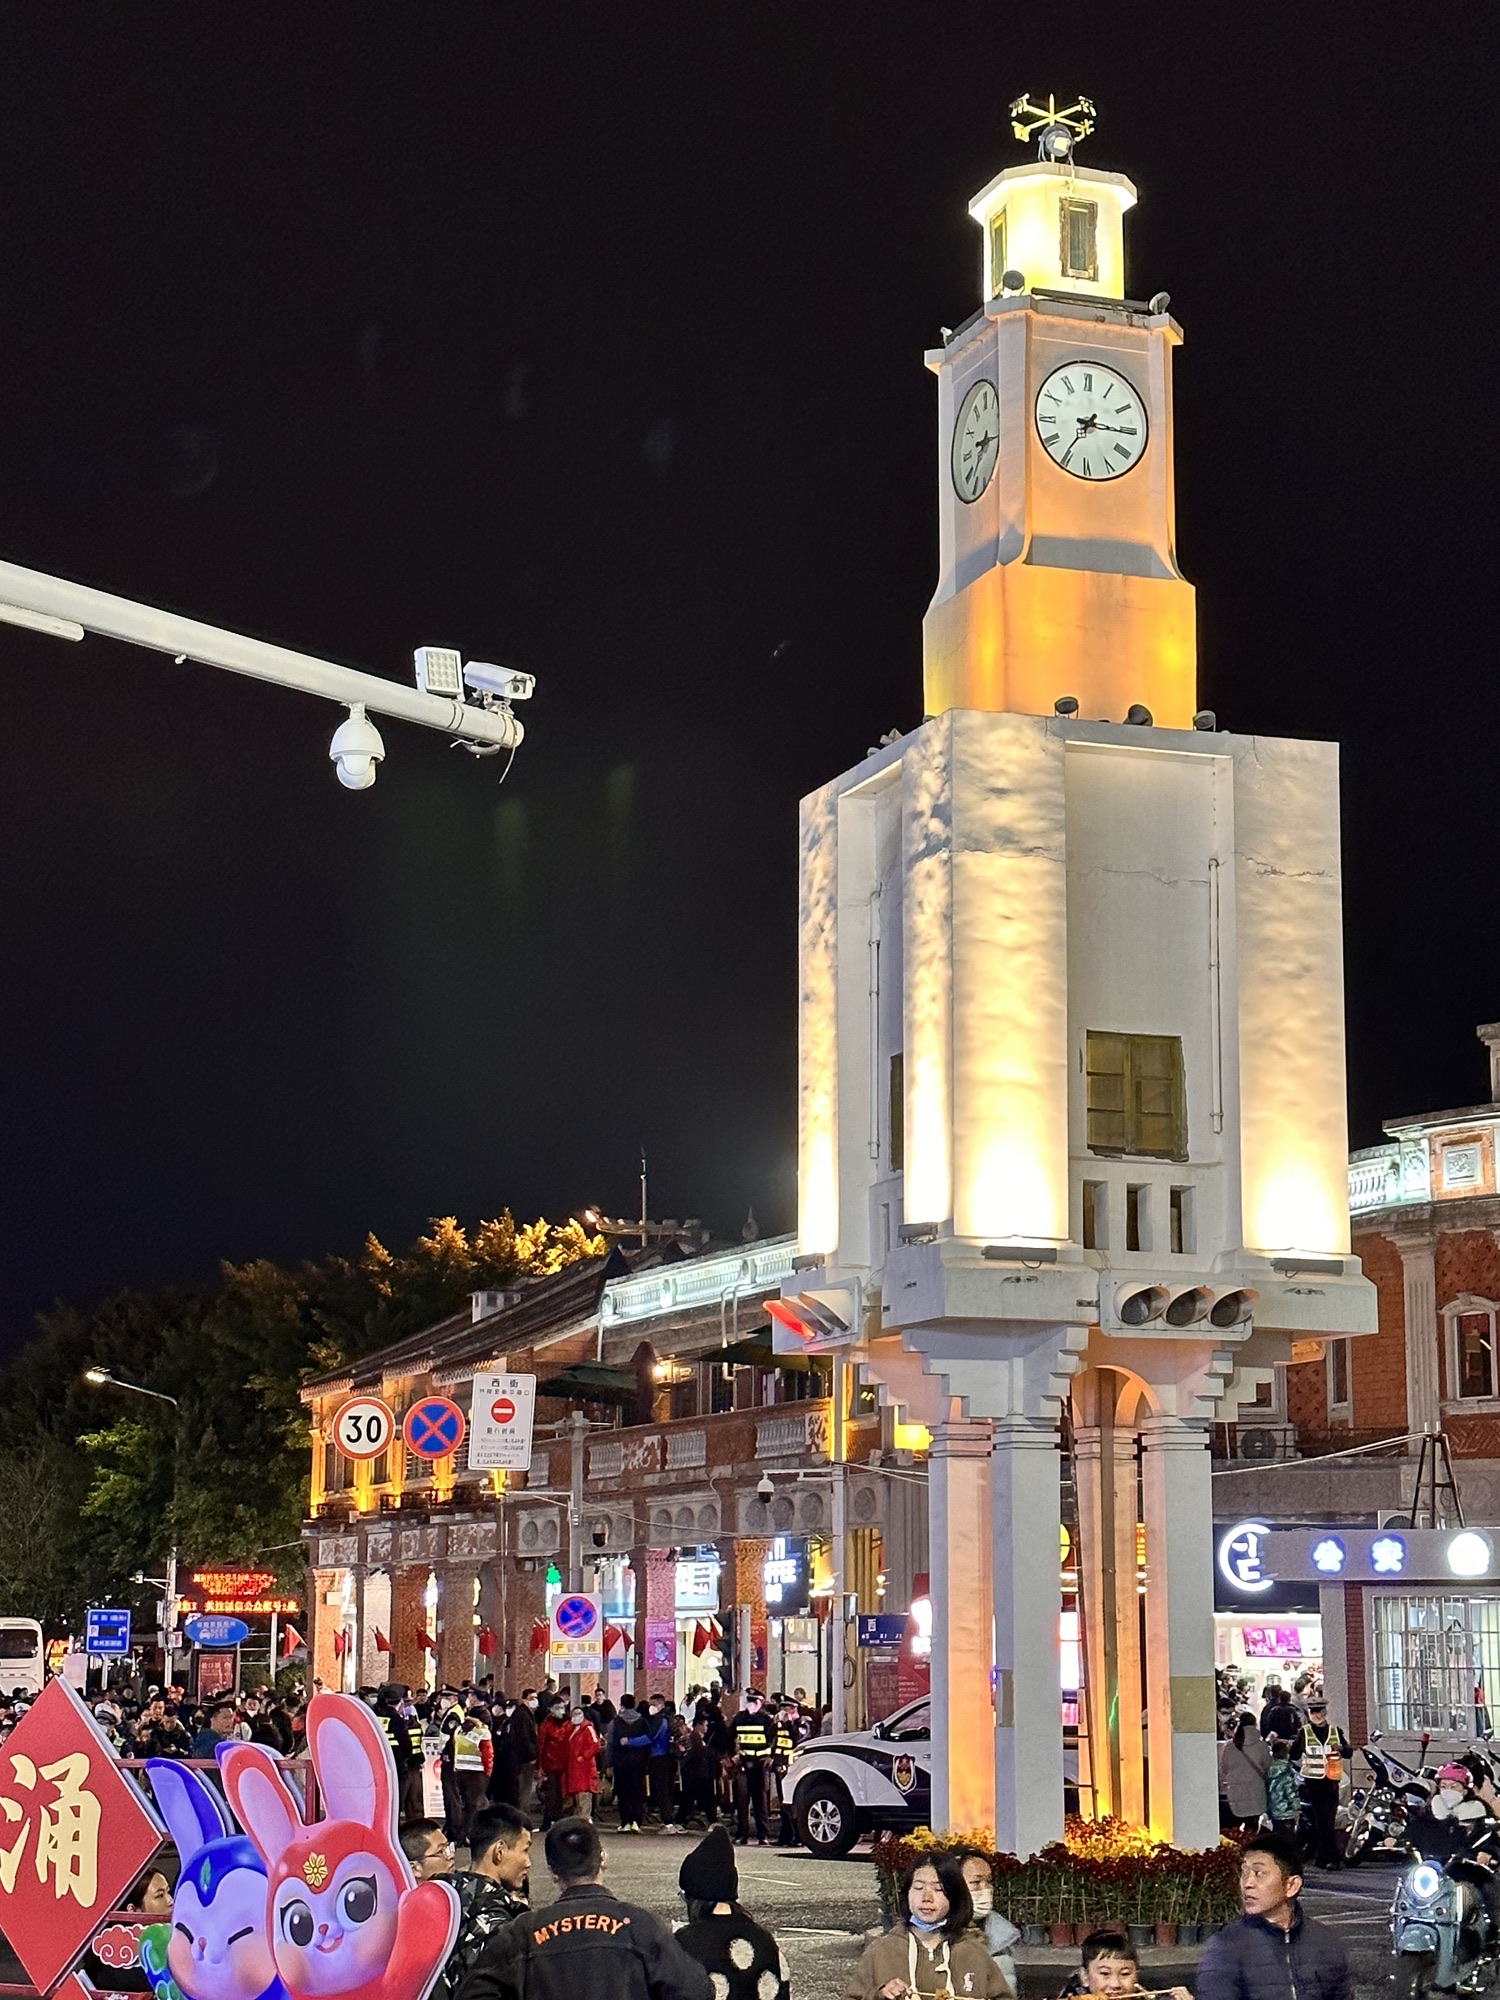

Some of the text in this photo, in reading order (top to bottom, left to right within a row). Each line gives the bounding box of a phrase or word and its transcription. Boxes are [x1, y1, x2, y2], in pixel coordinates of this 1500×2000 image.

[346, 1415, 382, 1444] 30
[0, 1752, 102, 1909] 涌
[533, 1914, 624, 1945] MYSTERY
